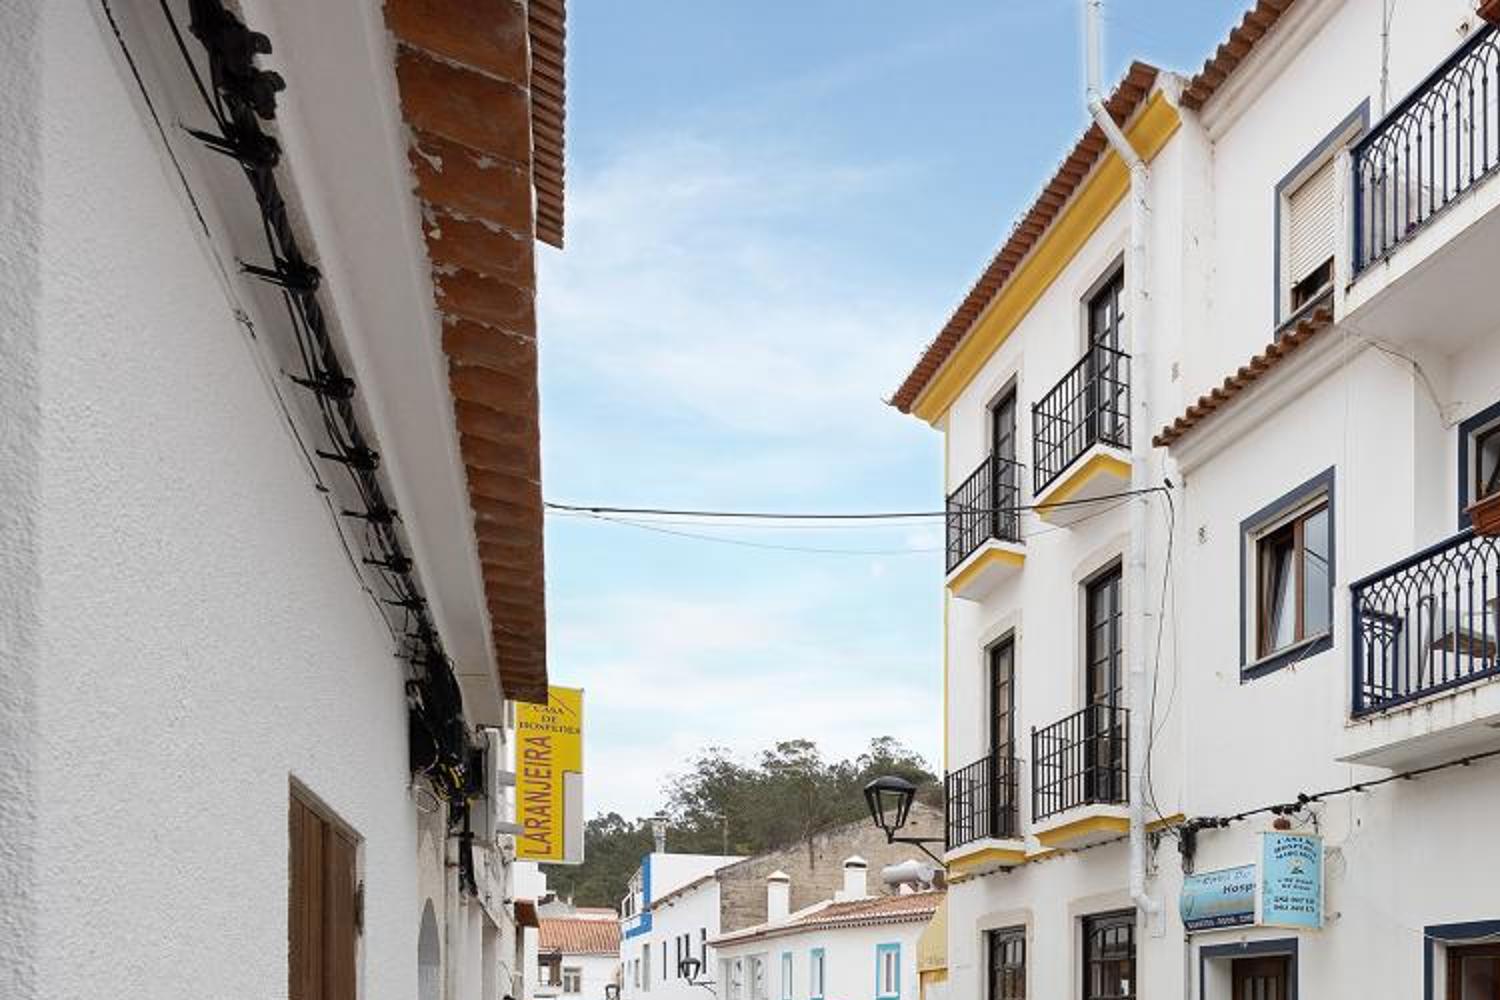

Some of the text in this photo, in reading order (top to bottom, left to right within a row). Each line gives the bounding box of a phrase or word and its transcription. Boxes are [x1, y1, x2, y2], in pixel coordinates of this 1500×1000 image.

[533, 704, 564, 715] CASA
[541, 714, 556, 723] DE
[524, 735, 551, 855] LARANJEIRA
